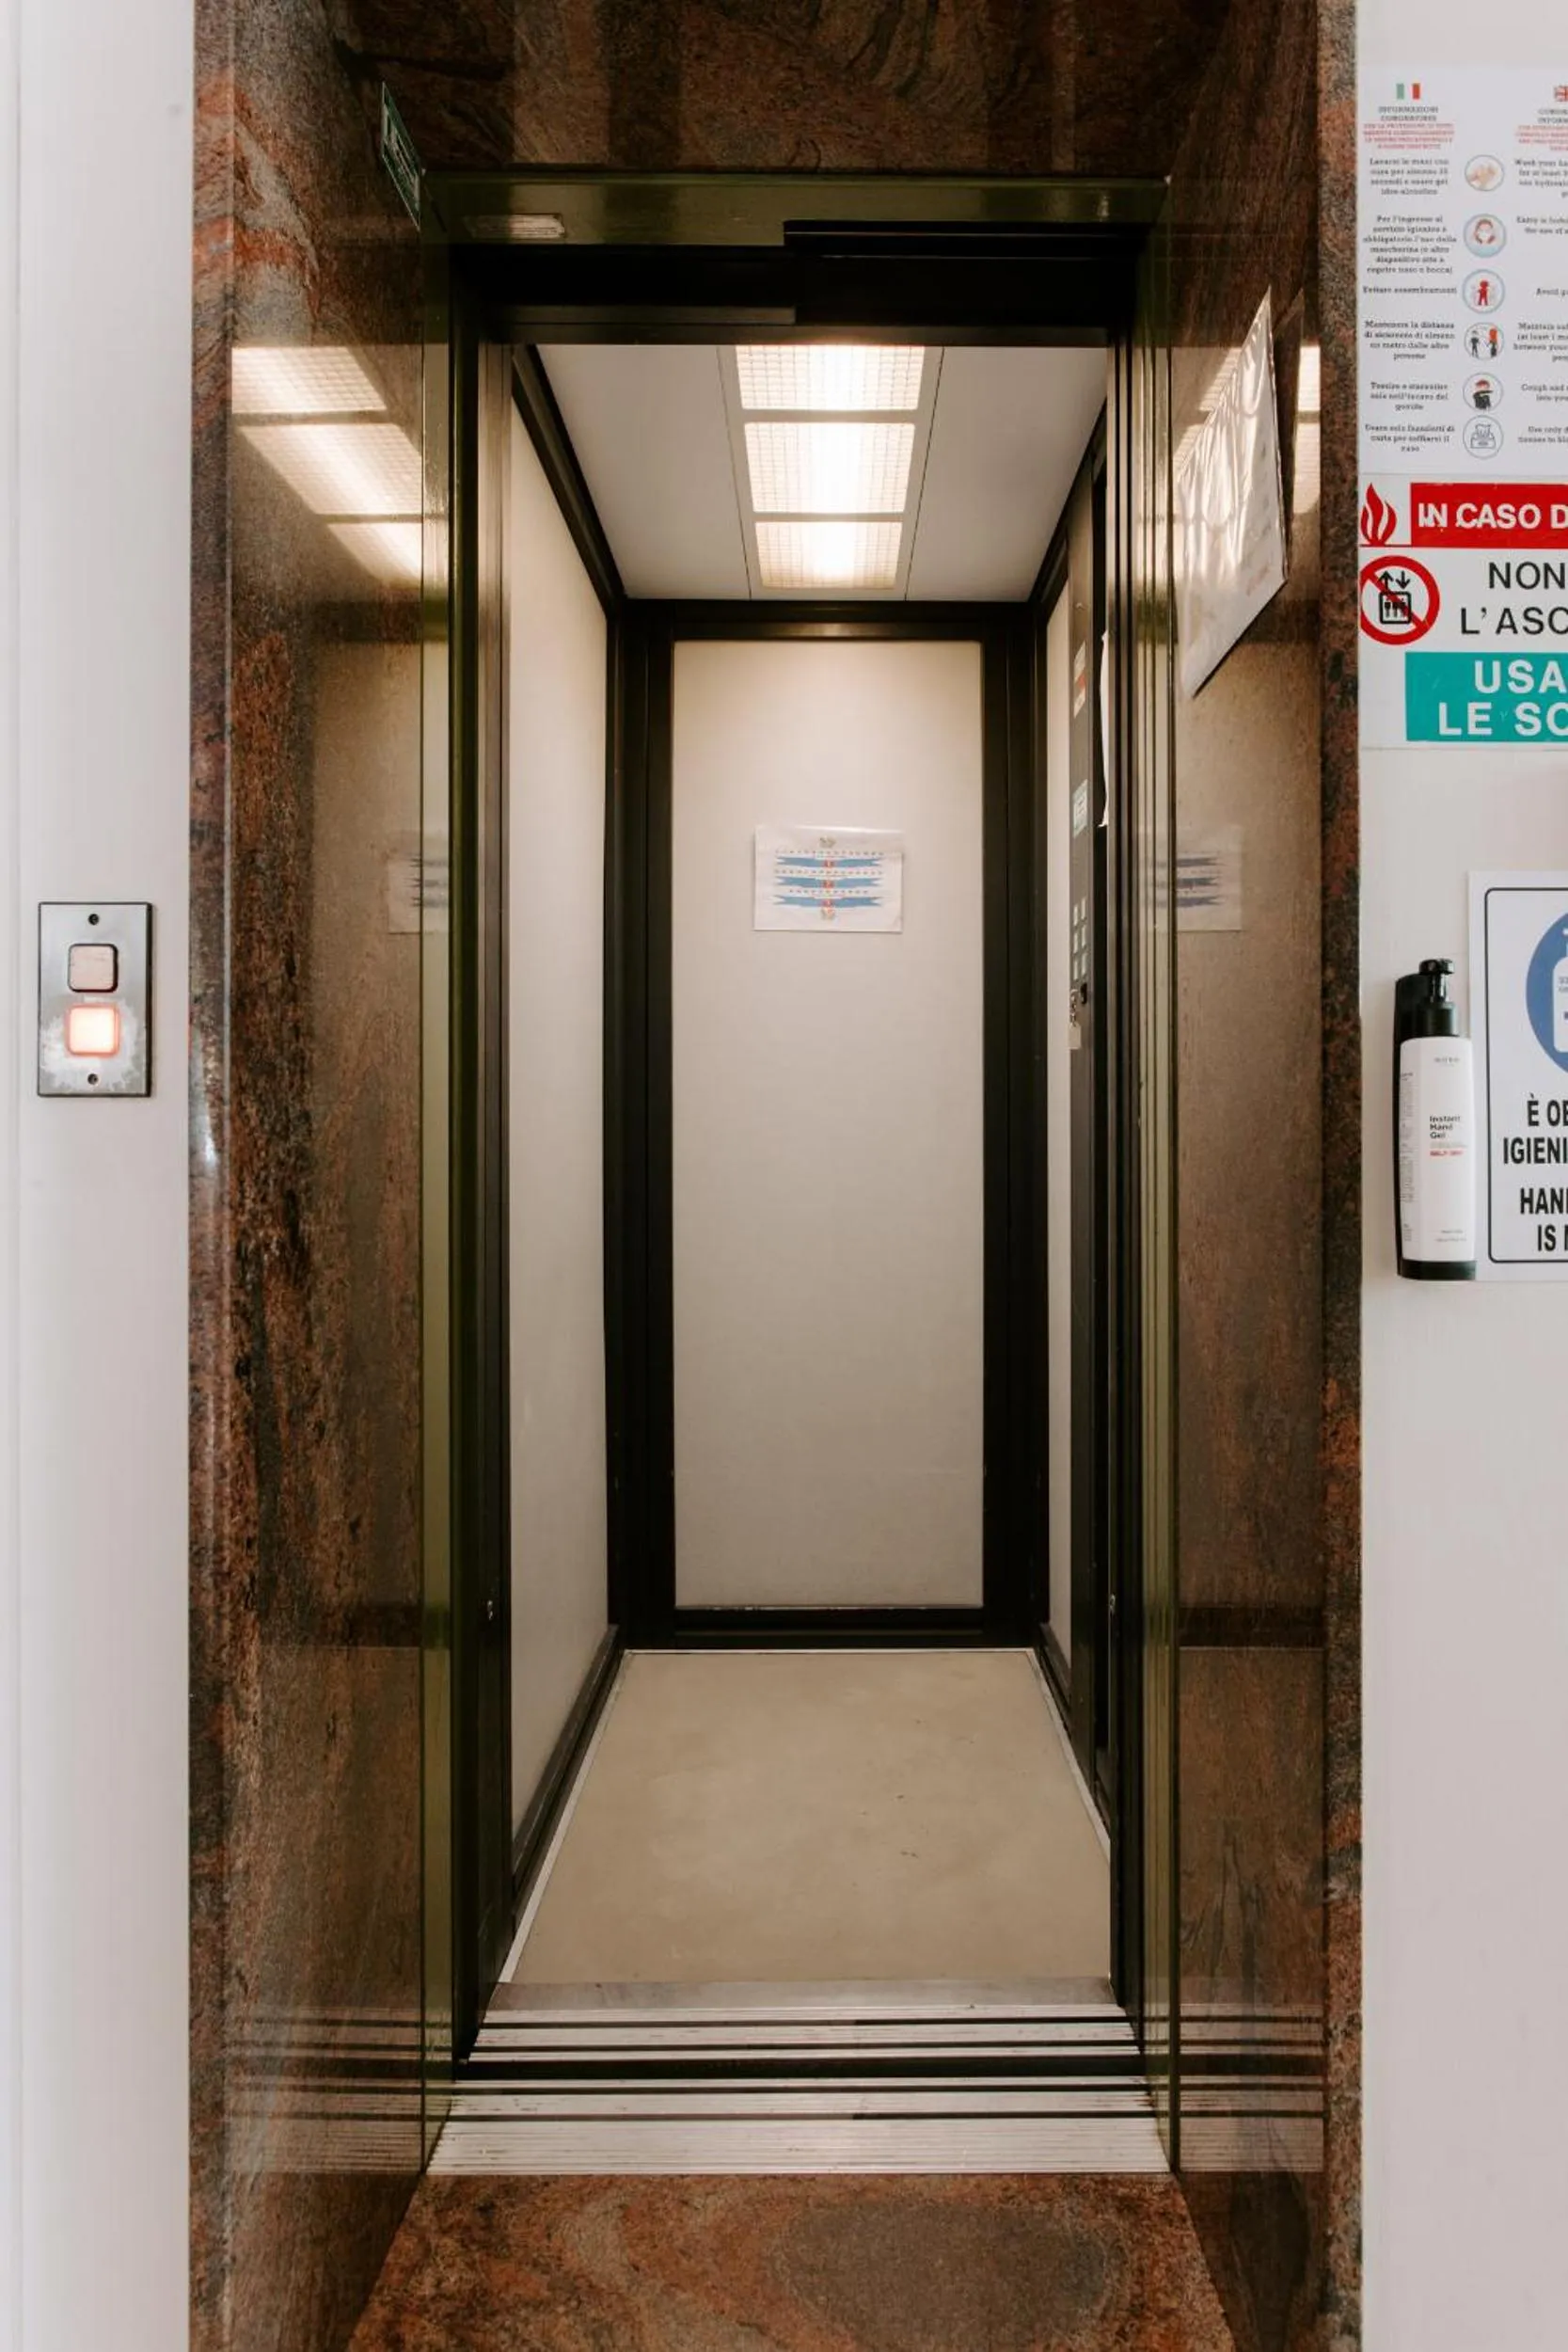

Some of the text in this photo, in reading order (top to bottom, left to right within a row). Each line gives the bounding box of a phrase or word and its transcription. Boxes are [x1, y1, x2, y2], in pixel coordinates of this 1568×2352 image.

[1418, 503, 1448, 528] IN
[1456, 502, 1542, 530] CASO
[1489, 562, 1565, 590] NON
[1474, 660, 1567, 694] USA
[1438, 702, 1493, 736] LE
[1528, 1093, 1540, 1126] È
[1503, 1137, 1567, 1164] IGIENI
[1520, 1188, 1568, 1215] HAN
[1538, 1225, 1557, 1252] IS
